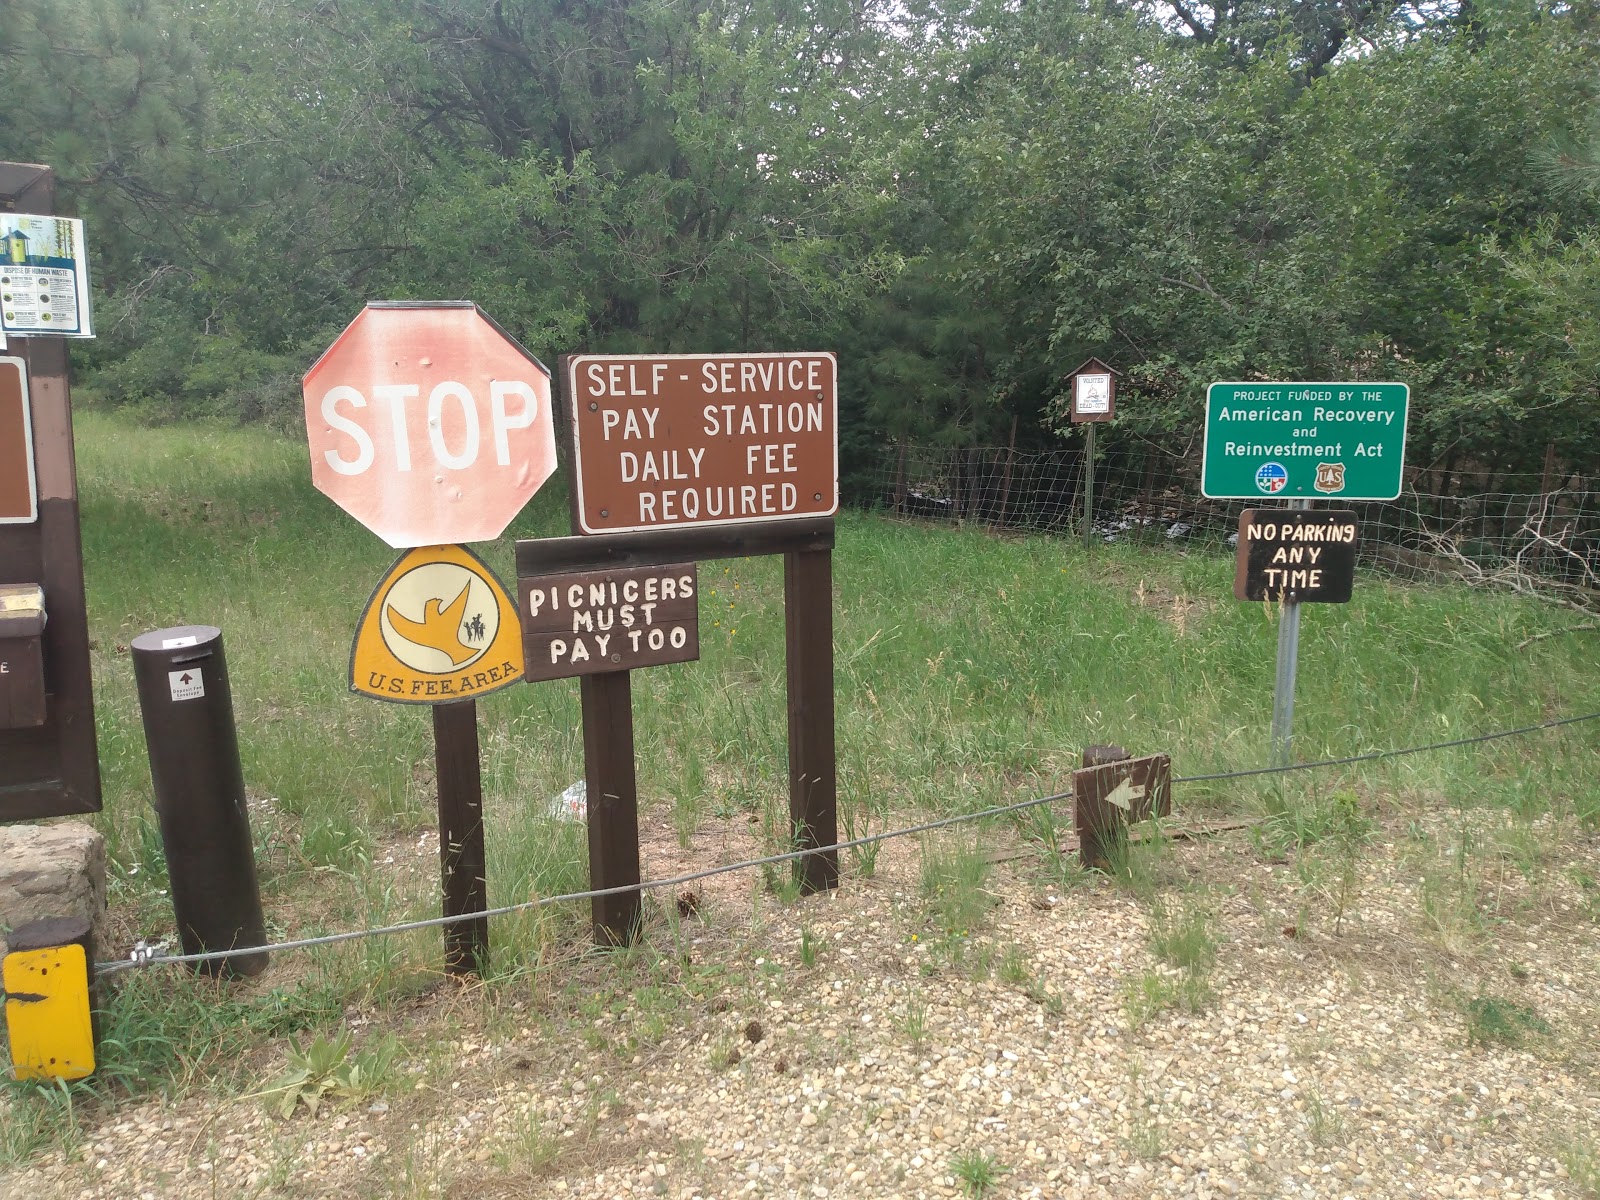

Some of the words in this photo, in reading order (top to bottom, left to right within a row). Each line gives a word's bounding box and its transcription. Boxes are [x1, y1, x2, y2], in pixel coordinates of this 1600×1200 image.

[587, 363, 668, 397] SELF
[701, 359, 822, 394] SERVICE
[1233, 390, 1282, 402] PROJECT
[1288, 390, 1332, 402] FUNDED
[1338, 391, 1354, 402] BY
[1362, 391, 1383, 402] THE
[320, 380, 538, 476] STOP
[602, 407, 660, 441] PAY
[703, 402, 823, 436] STATION
[1218, 406, 1302, 422] American
[1314, 407, 1395, 426] Recovery
[1292, 426, 1318, 438] and
[620, 447, 705, 483] DAILY
[746, 443, 798, 475] FEE
[1224, 442, 1342, 456] Reinvestment
[1354, 442, 1384, 457] Act
[639, 482, 797, 522] REQUIRED
[1247, 523, 1276, 541] NO
[1272, 546, 1322, 564] ANY
[1264, 568, 1323, 588] TIME
[529, 575, 694, 617] PICNICERS
[572, 602, 658, 634] MUST
[550, 633, 612, 664] PAY
[628, 626, 687, 652] TOO
[368, 672, 405, 694] U.S.
[459, 660, 518, 692] AREA
